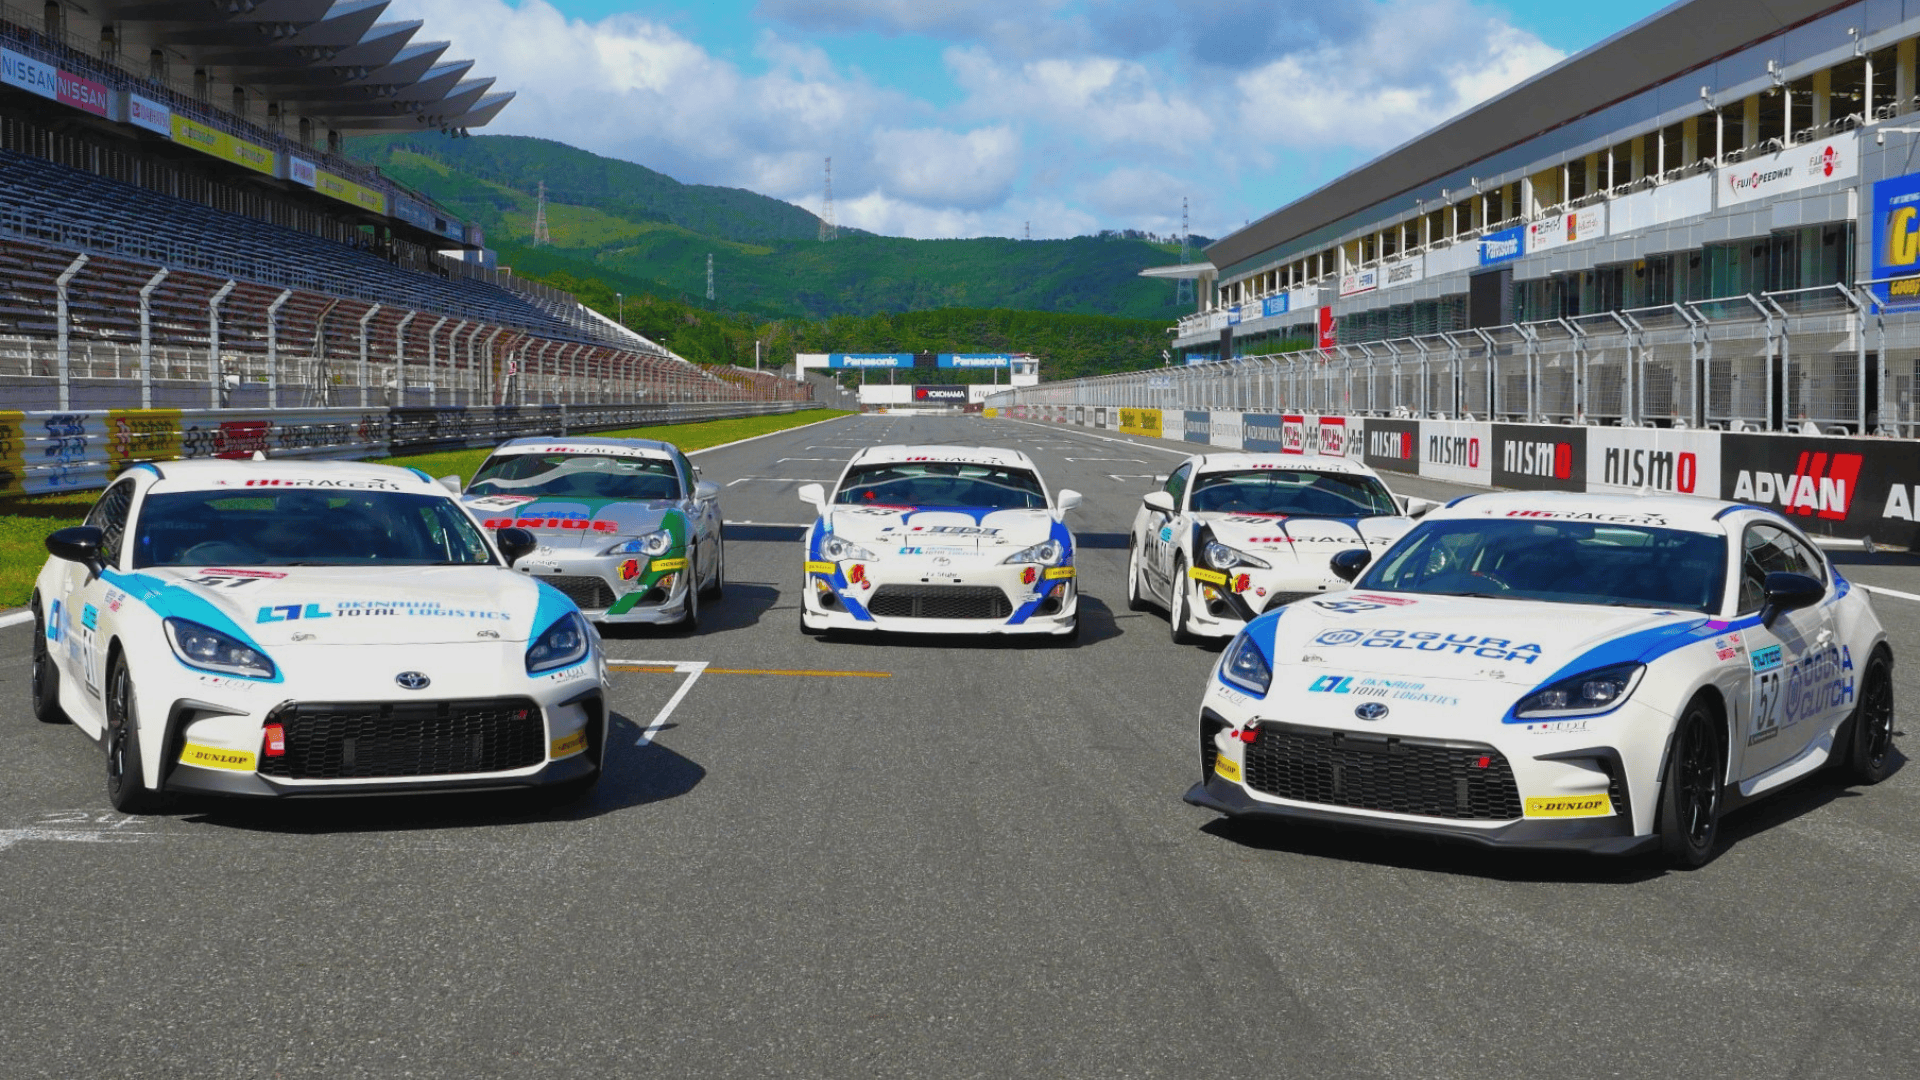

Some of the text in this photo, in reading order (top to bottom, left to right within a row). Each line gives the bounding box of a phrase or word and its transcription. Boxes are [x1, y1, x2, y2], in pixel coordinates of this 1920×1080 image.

[2, 55, 55, 92] NISSAN
[58, 76, 106, 109] NISSAN
[843, 355, 898, 366] Panasonic
[953, 355, 1007, 366] Panasonic
[927, 390, 965, 398] YOKOHAMA
[1733, 470, 1844, 512] ADVAN
[336, 608, 511, 621] TOTAL LOGISTICS
[1361, 637, 1540, 664] CLUTCH
[1373, 629, 1543, 654] OGURA
[1803, 645, 1853, 687] OGURA
[1352, 686, 1459, 706] TOTAL LOGISTICS
[1757, 672, 1780, 731] 52
[1800, 675, 1854, 719] CLUTCH
[195, 751, 248, 765] DUNLOP
[1545, 801, 1602, 811] DUNLOP
